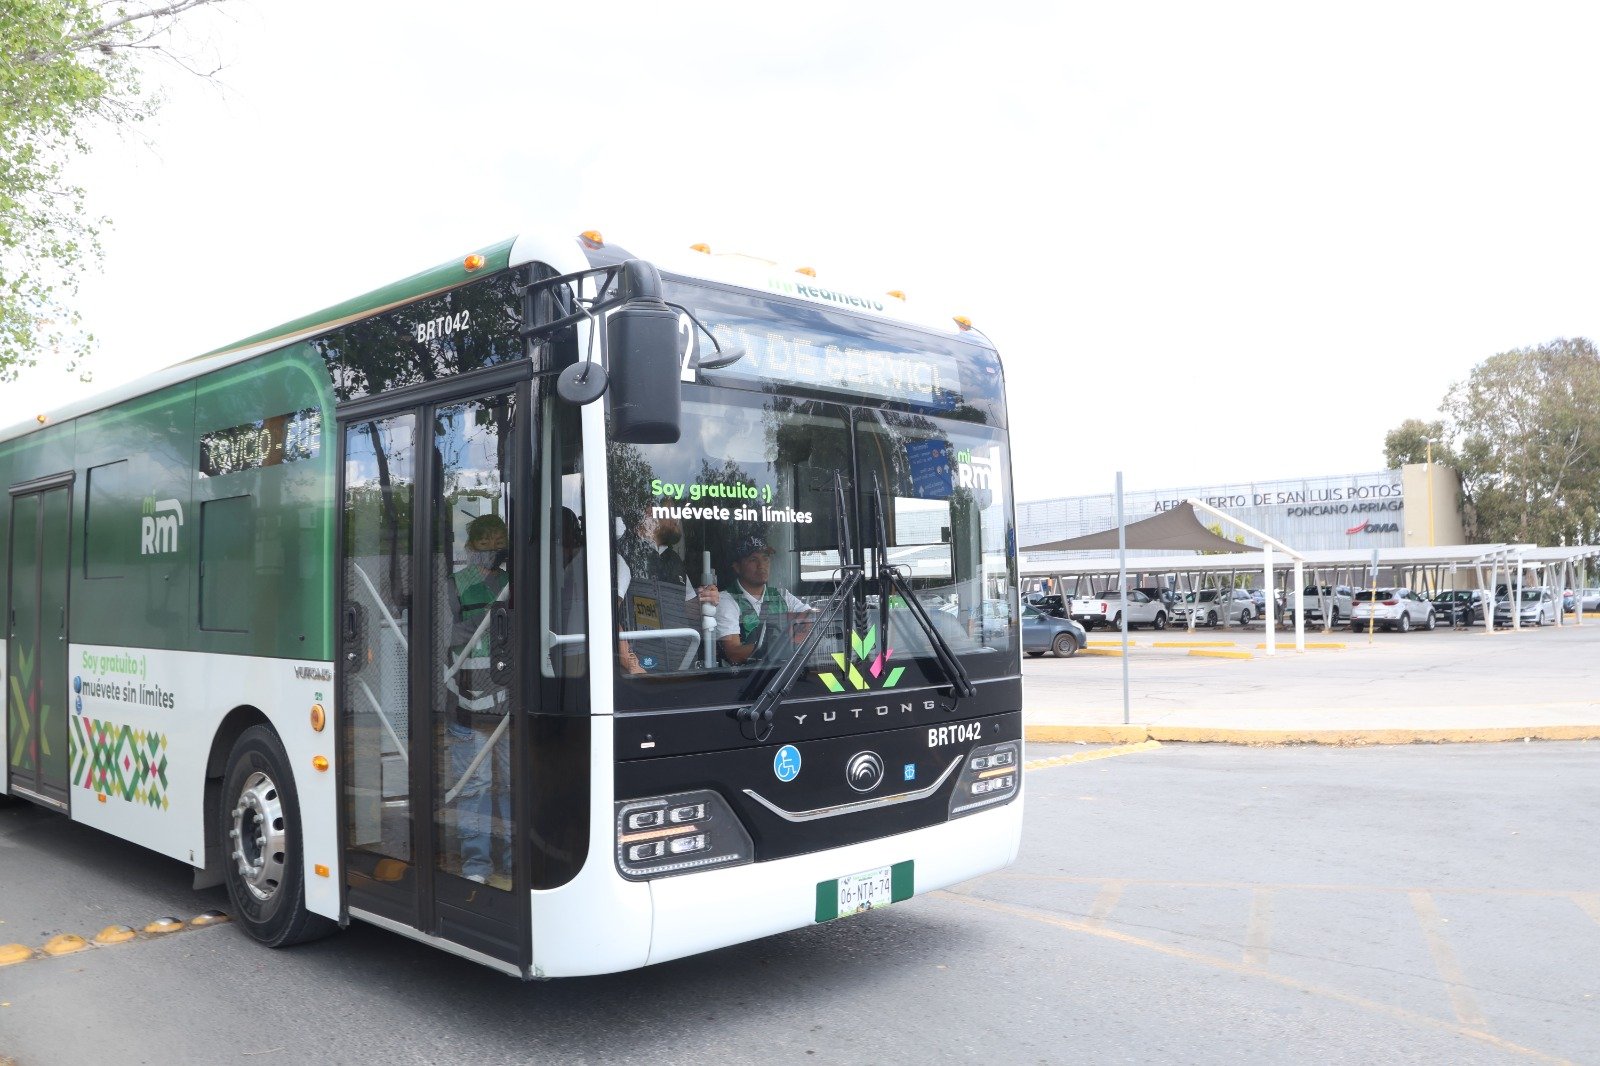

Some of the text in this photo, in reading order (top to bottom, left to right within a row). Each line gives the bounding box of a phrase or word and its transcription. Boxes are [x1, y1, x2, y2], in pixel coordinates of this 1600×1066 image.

[416, 309, 470, 344] BRT042
[957, 448, 972, 465] mi
[651, 479, 685, 500] Soy
[689, 481, 758, 501] gratuito
[1253, 492, 1272, 506] DE
[1276, 491, 1306, 504] SAN
[1310, 487, 1342, 502] LUIS
[1347, 483, 1403, 499] POTOS
[652, 503, 813, 524] muévete sin límites
[1287, 500, 1404, 517] PONCIANO ARRIAGA
[1363, 522, 1399, 534] OMA
[82, 650, 98, 674] Soy
[100, 652, 138, 676] gratuito
[82, 678, 175, 710] muévete sin límites
[794, 700, 935, 725] YUTONG
[928, 722, 982, 748] BRT042
[840, 878, 891, 905] 06-NTA-74
